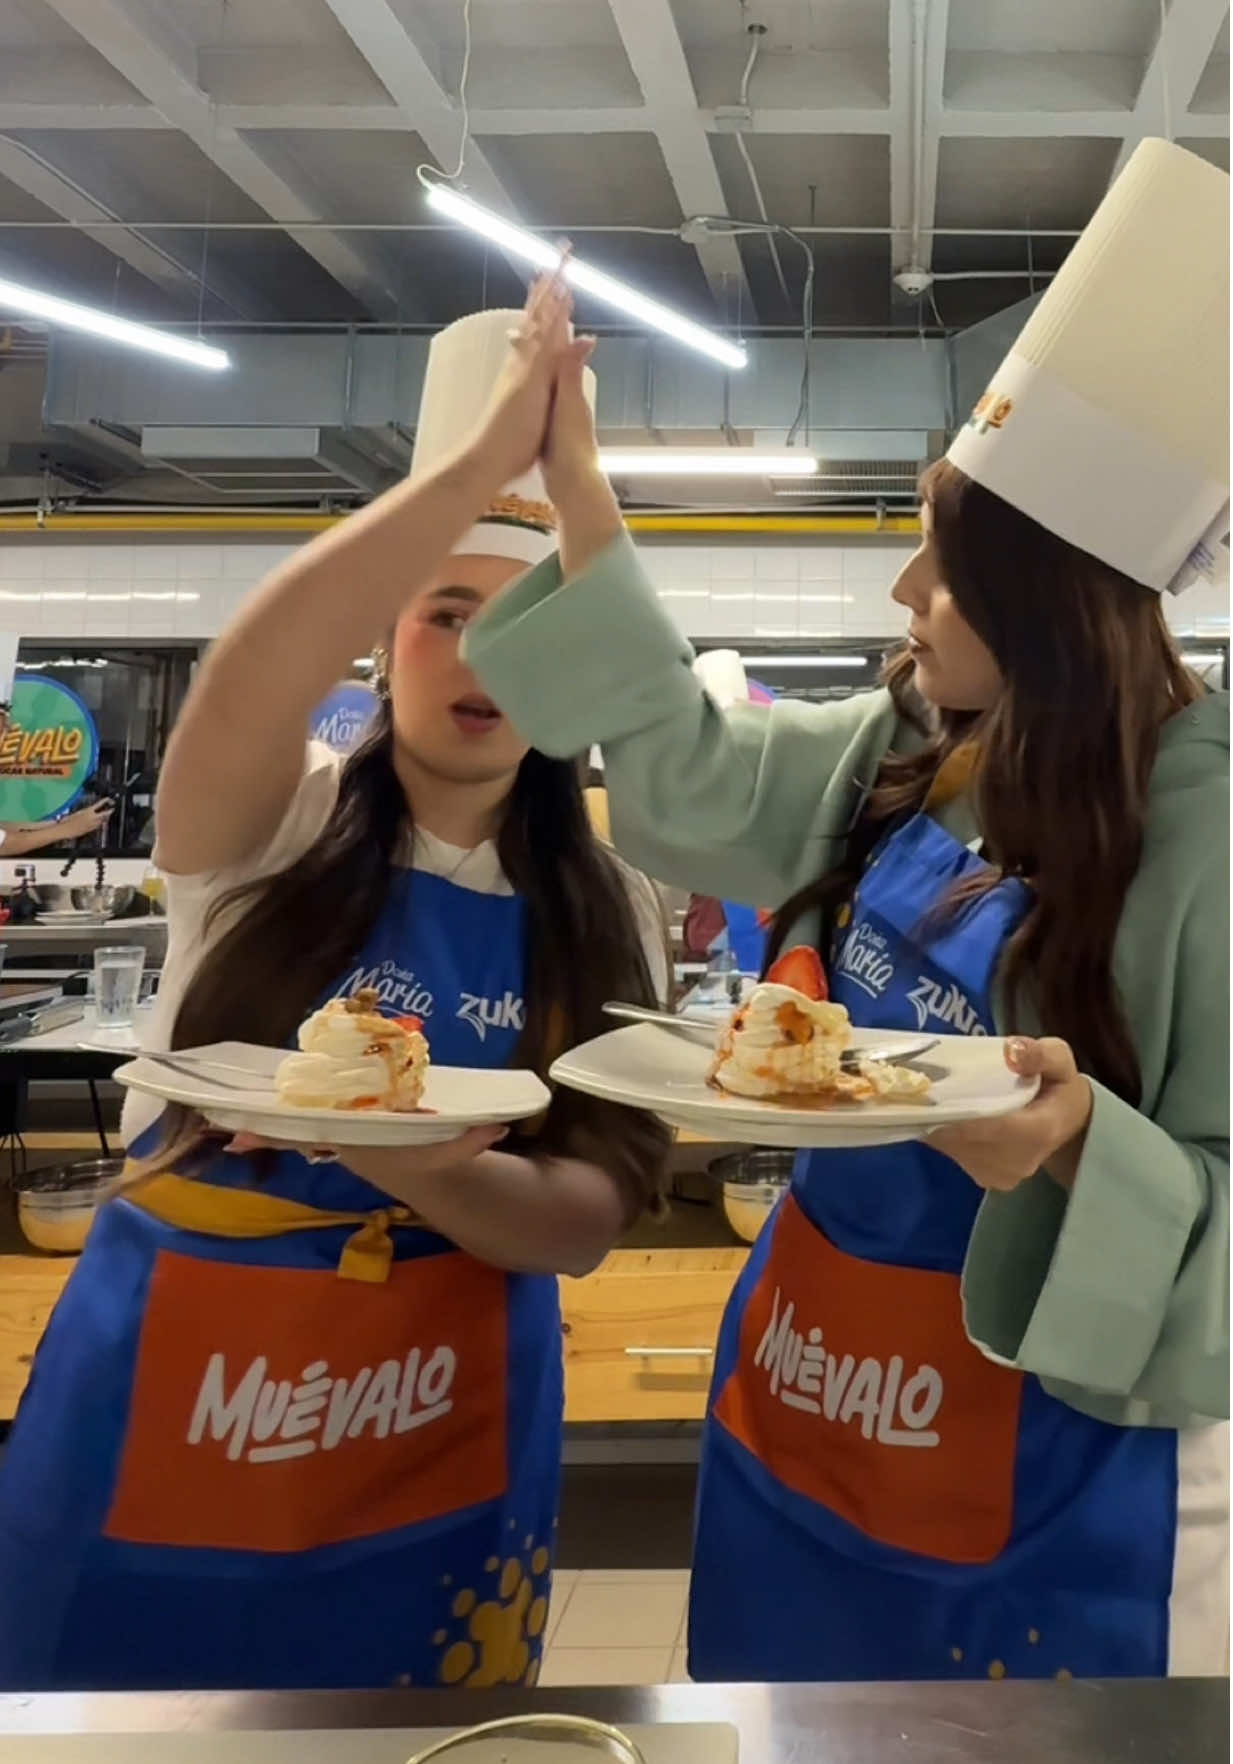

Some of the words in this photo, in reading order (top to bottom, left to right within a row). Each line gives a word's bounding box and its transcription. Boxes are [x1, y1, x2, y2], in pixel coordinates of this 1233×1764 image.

[336, 967, 433, 1017] María
[455, 991, 526, 1042] ZUK
[187, 1346, 456, 1463] MUÉVALO
[757, 1286, 943, 1447] MUÉVALO
